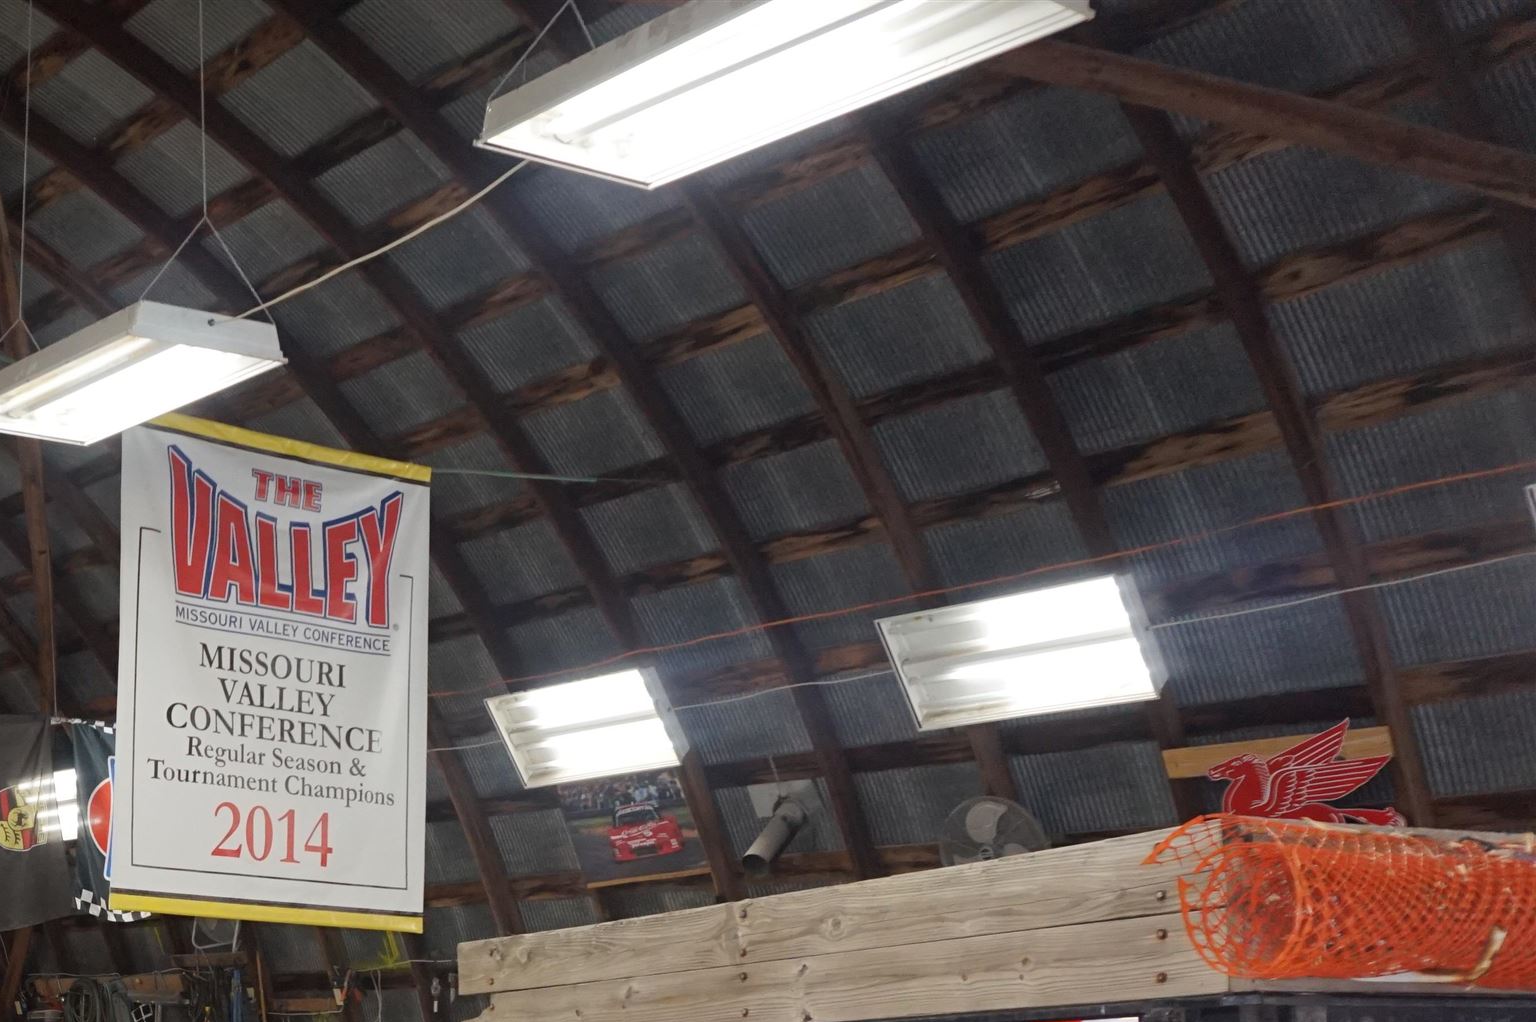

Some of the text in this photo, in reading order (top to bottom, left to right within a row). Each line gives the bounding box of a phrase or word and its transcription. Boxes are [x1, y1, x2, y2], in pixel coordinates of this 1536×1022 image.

[252, 468, 323, 512] THE
[167, 444, 404, 629] VALLEY
[175, 605, 390, 652] MISSOURI VALLEY CONFERENCE
[199, 642, 346, 689] MISSOURI
[217, 677, 336, 718] VALLEY
[166, 702, 383, 754] CONFERENCE
[186, 736, 366, 777] Regular Season &
[147, 758, 395, 807] Tournament Champions
[211, 801, 334, 867] 2014
